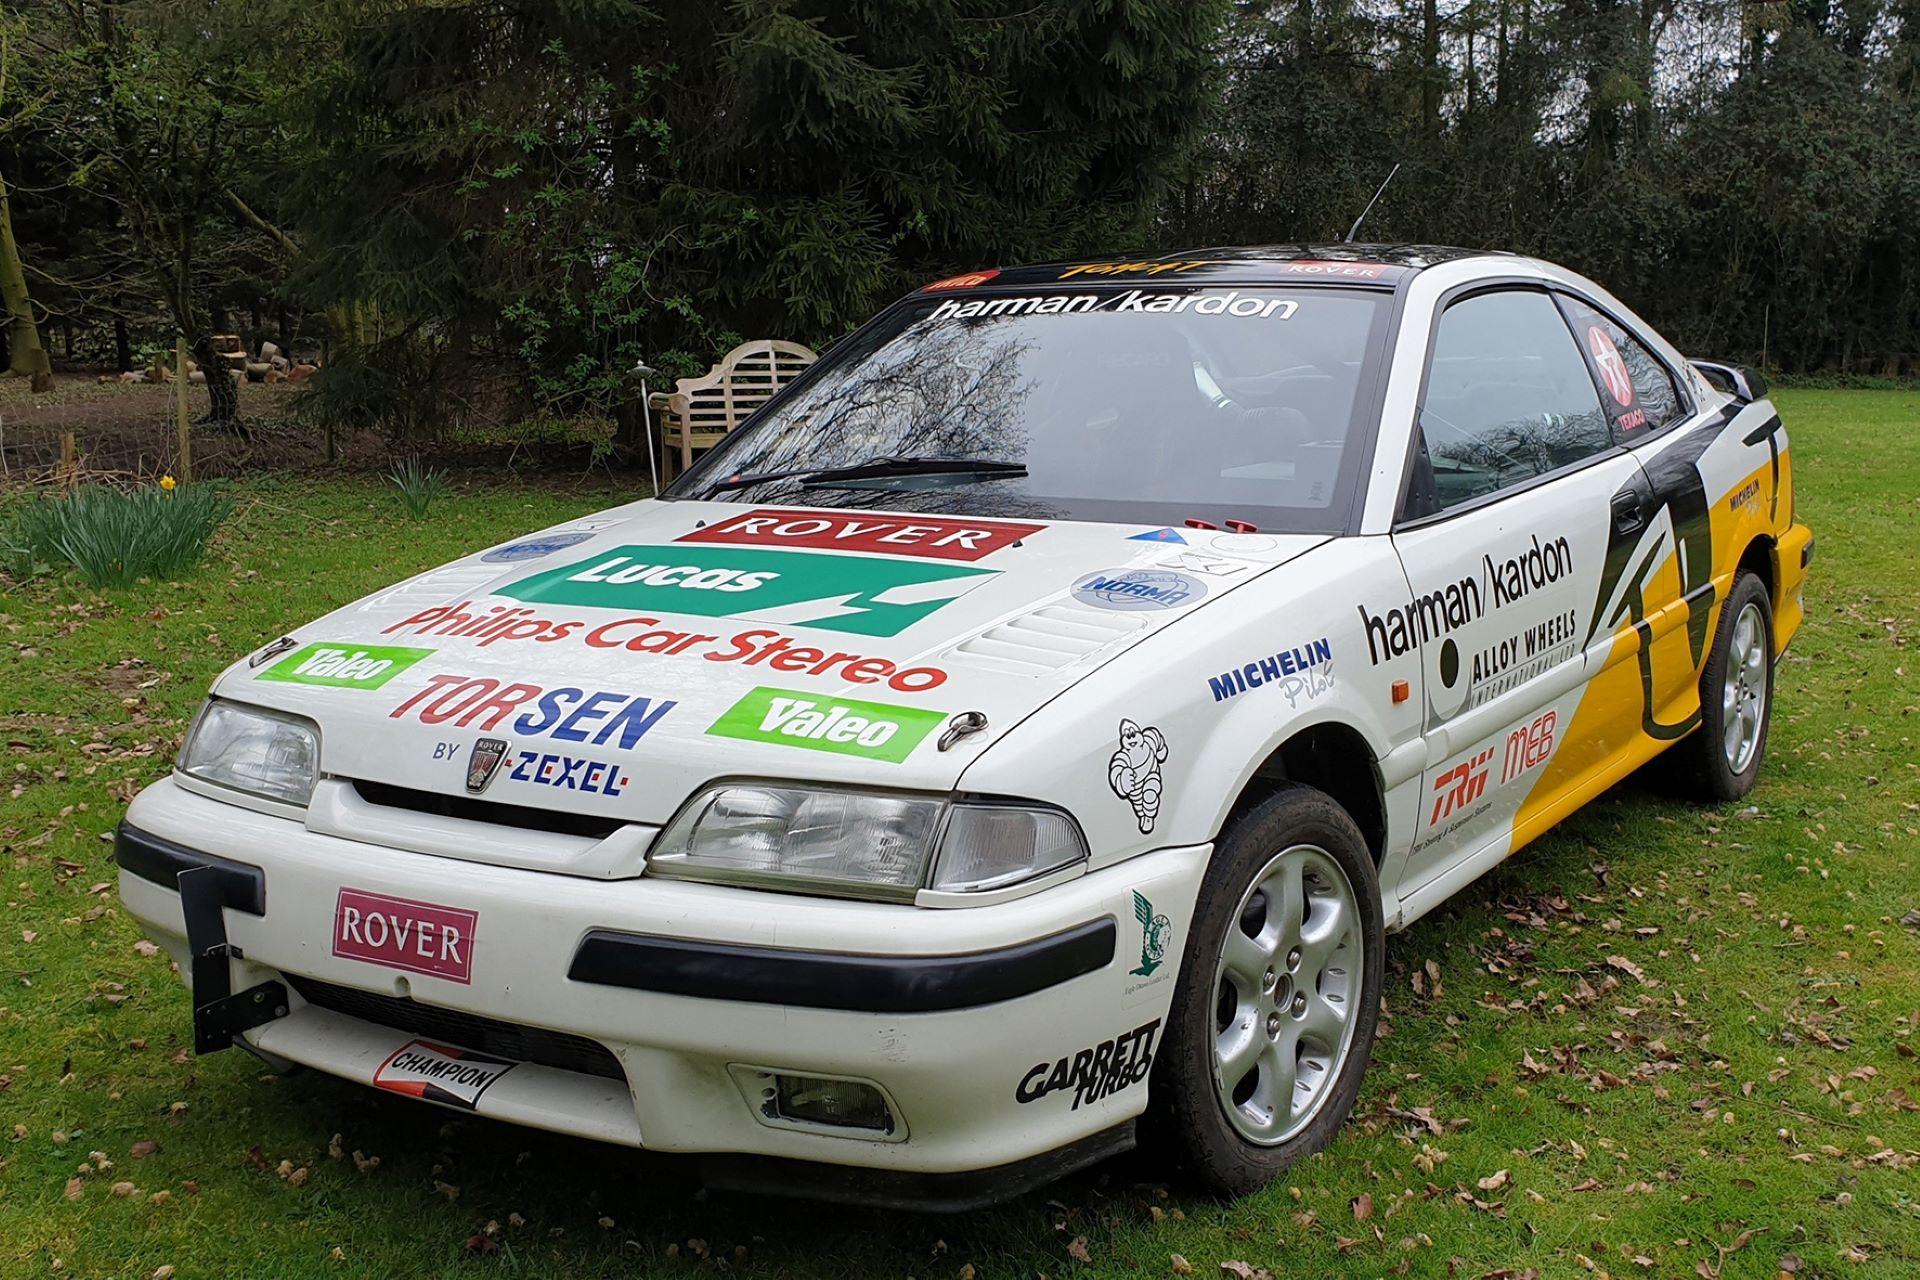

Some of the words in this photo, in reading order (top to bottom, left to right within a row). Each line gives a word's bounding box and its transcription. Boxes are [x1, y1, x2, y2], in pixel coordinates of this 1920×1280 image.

[1288, 265, 1375, 278] ROVER
[931, 289, 1300, 321] harman/kardon
[1618, 407, 1645, 431] TEXACO
[1729, 478, 1760, 512] MICHELIN
[729, 515, 995, 551] ROVER
[567, 556, 783, 594] Lucas
[1080, 575, 1191, 605] NORMA
[1357, 534, 1572, 666] harman/kardon
[292, 648, 394, 681] Valeo
[380, 600, 586, 648] Philips
[584, 616, 717, 656] Car
[703, 630, 949, 693] Stereo
[1472, 635, 1518, 685] ALLOY
[1524, 609, 1576, 657] WHEELS
[1208, 637, 1332, 702] MICHELIN
[1279, 660, 1336, 709] Pilot
[389, 674, 678, 751] TORSEN
[758, 697, 900, 748] Valeo
[432, 742, 461, 761] BY
[478, 741, 504, 751] ROVER
[510, 751, 623, 796] ZEXEL
[1430, 745, 1495, 827] TRW
[341, 906, 463, 964] ROVER
[392, 1052, 493, 1088] CHAMPION
[1015, 1016, 1162, 1104] GARRETT
[1071, 1053, 1152, 1111] TURBO
